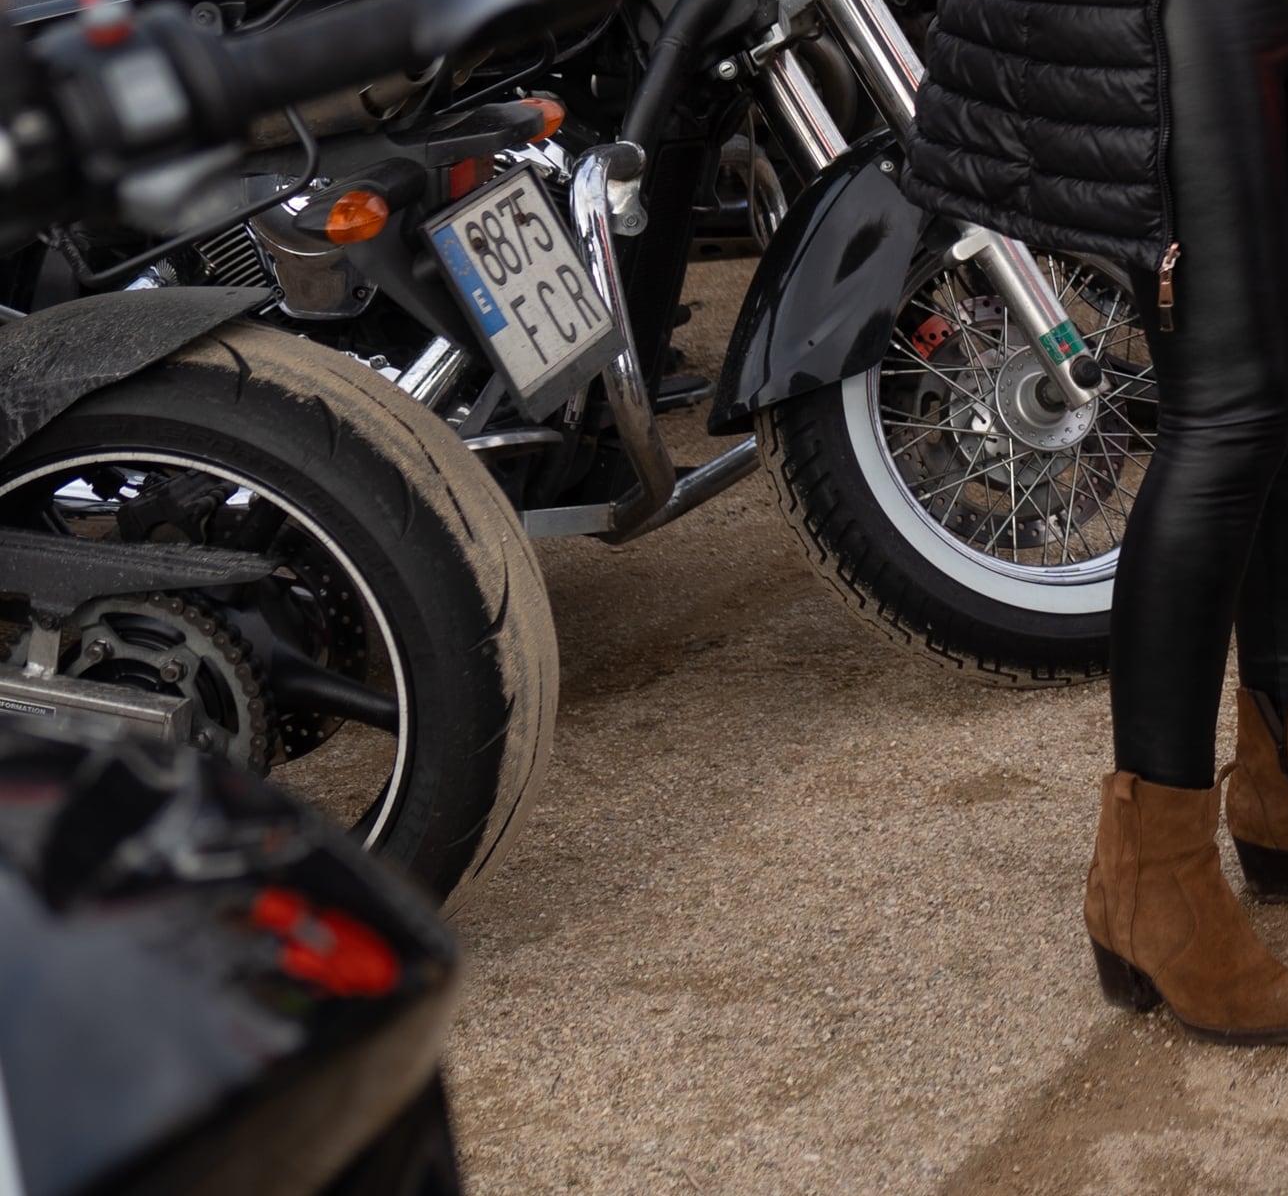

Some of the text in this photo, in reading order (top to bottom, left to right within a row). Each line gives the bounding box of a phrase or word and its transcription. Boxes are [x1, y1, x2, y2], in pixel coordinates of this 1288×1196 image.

[465, 187, 553, 286] 8875
[471, 288, 492, 315] E
[510, 264, 601, 365] FCR
[0, 700, 47, 716] FORMATION
